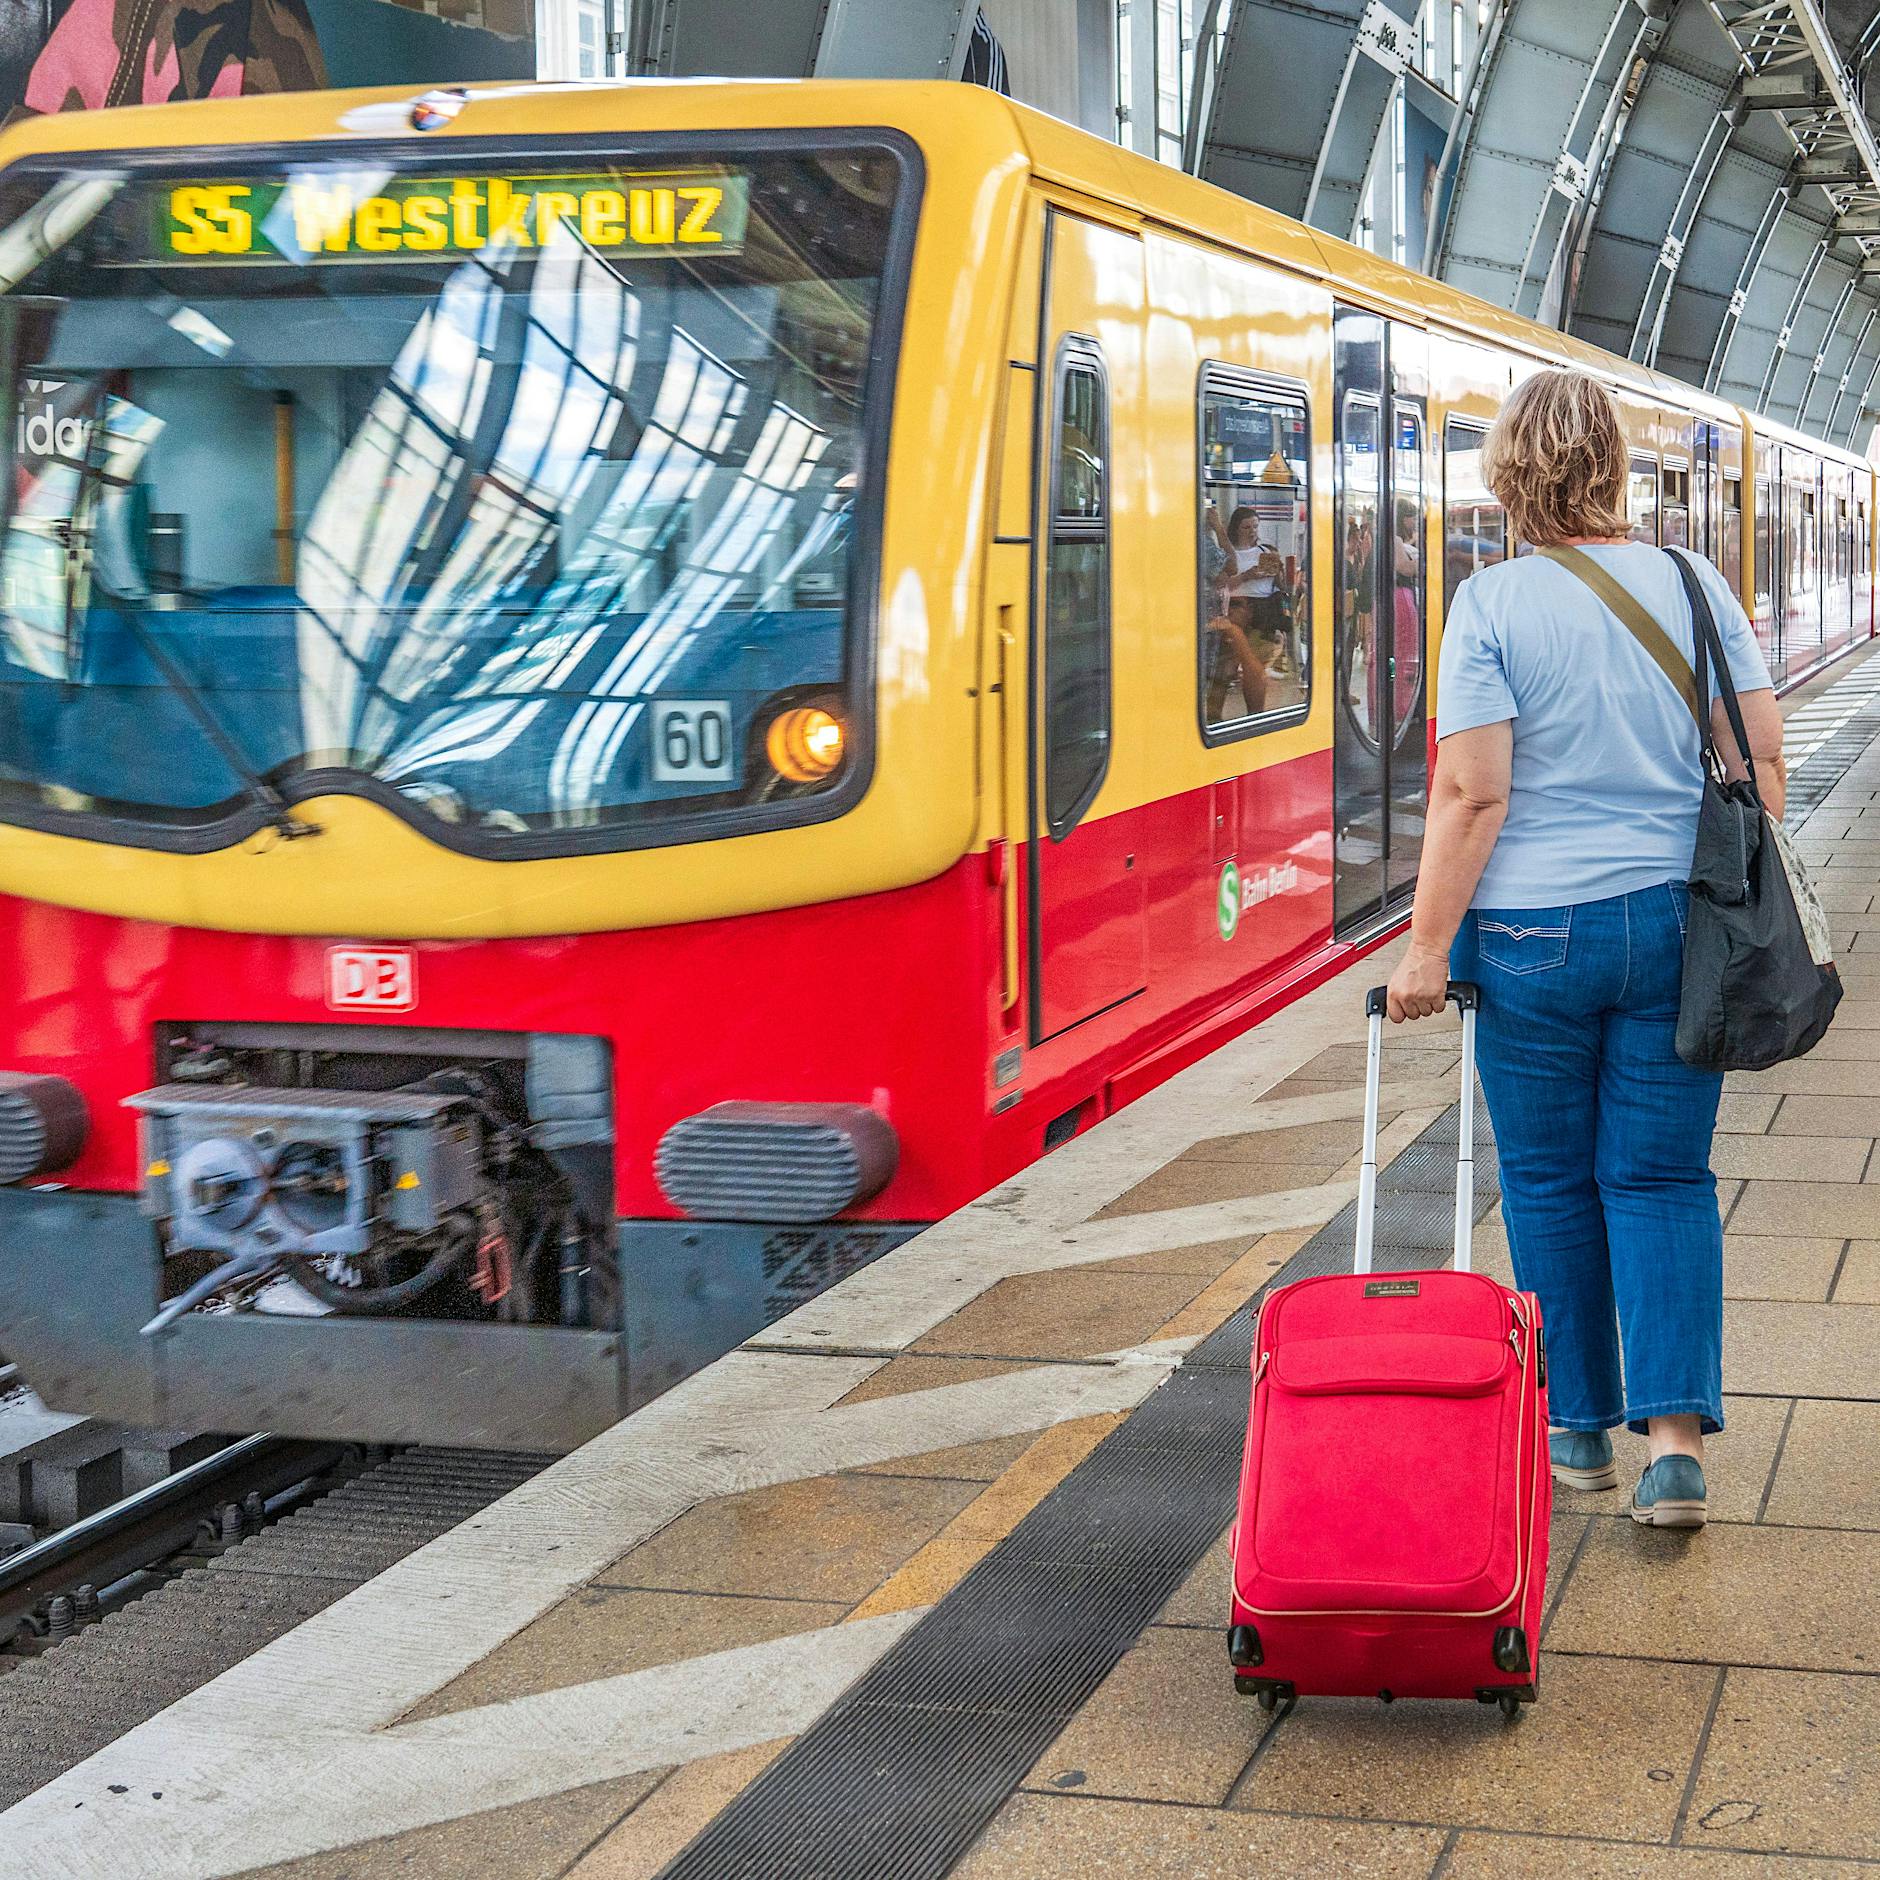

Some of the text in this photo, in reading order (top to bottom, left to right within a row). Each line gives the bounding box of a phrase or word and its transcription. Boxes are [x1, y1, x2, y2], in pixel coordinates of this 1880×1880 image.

[170, 176, 723, 254] S5 Westkreuz
[665, 710, 722, 769] 60
[1220, 859, 1298, 932] S Bahn Berlin
[341, 956, 405, 1001] DB
